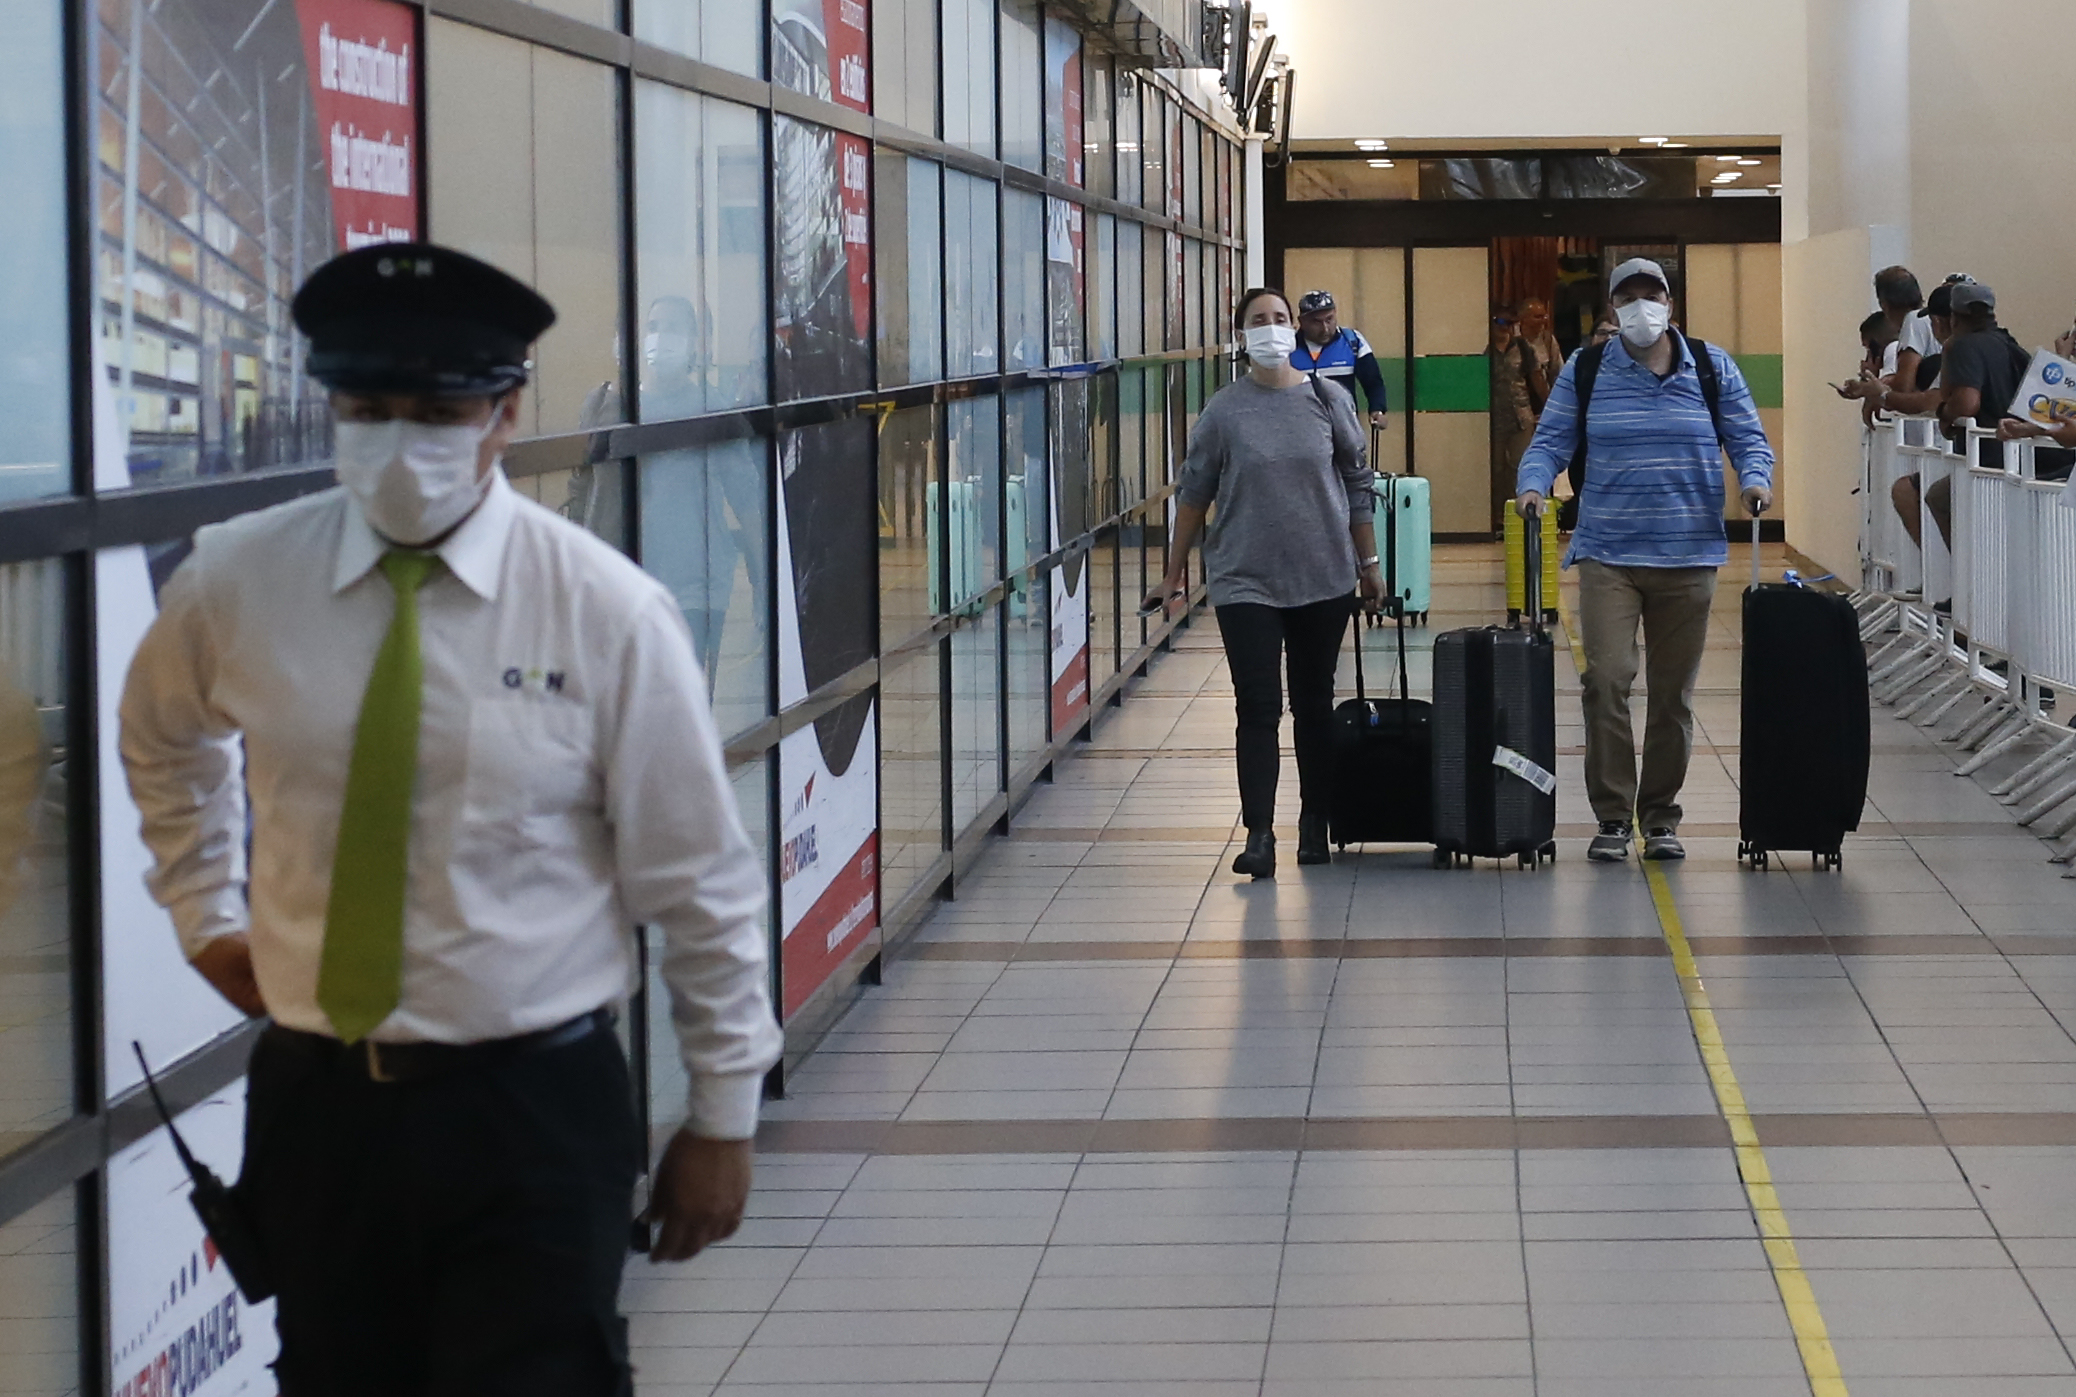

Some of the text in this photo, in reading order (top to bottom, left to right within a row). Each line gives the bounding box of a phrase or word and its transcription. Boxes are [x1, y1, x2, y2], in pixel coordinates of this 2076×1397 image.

[319, 22, 338, 91] the
[331, 121, 410, 197] the international
